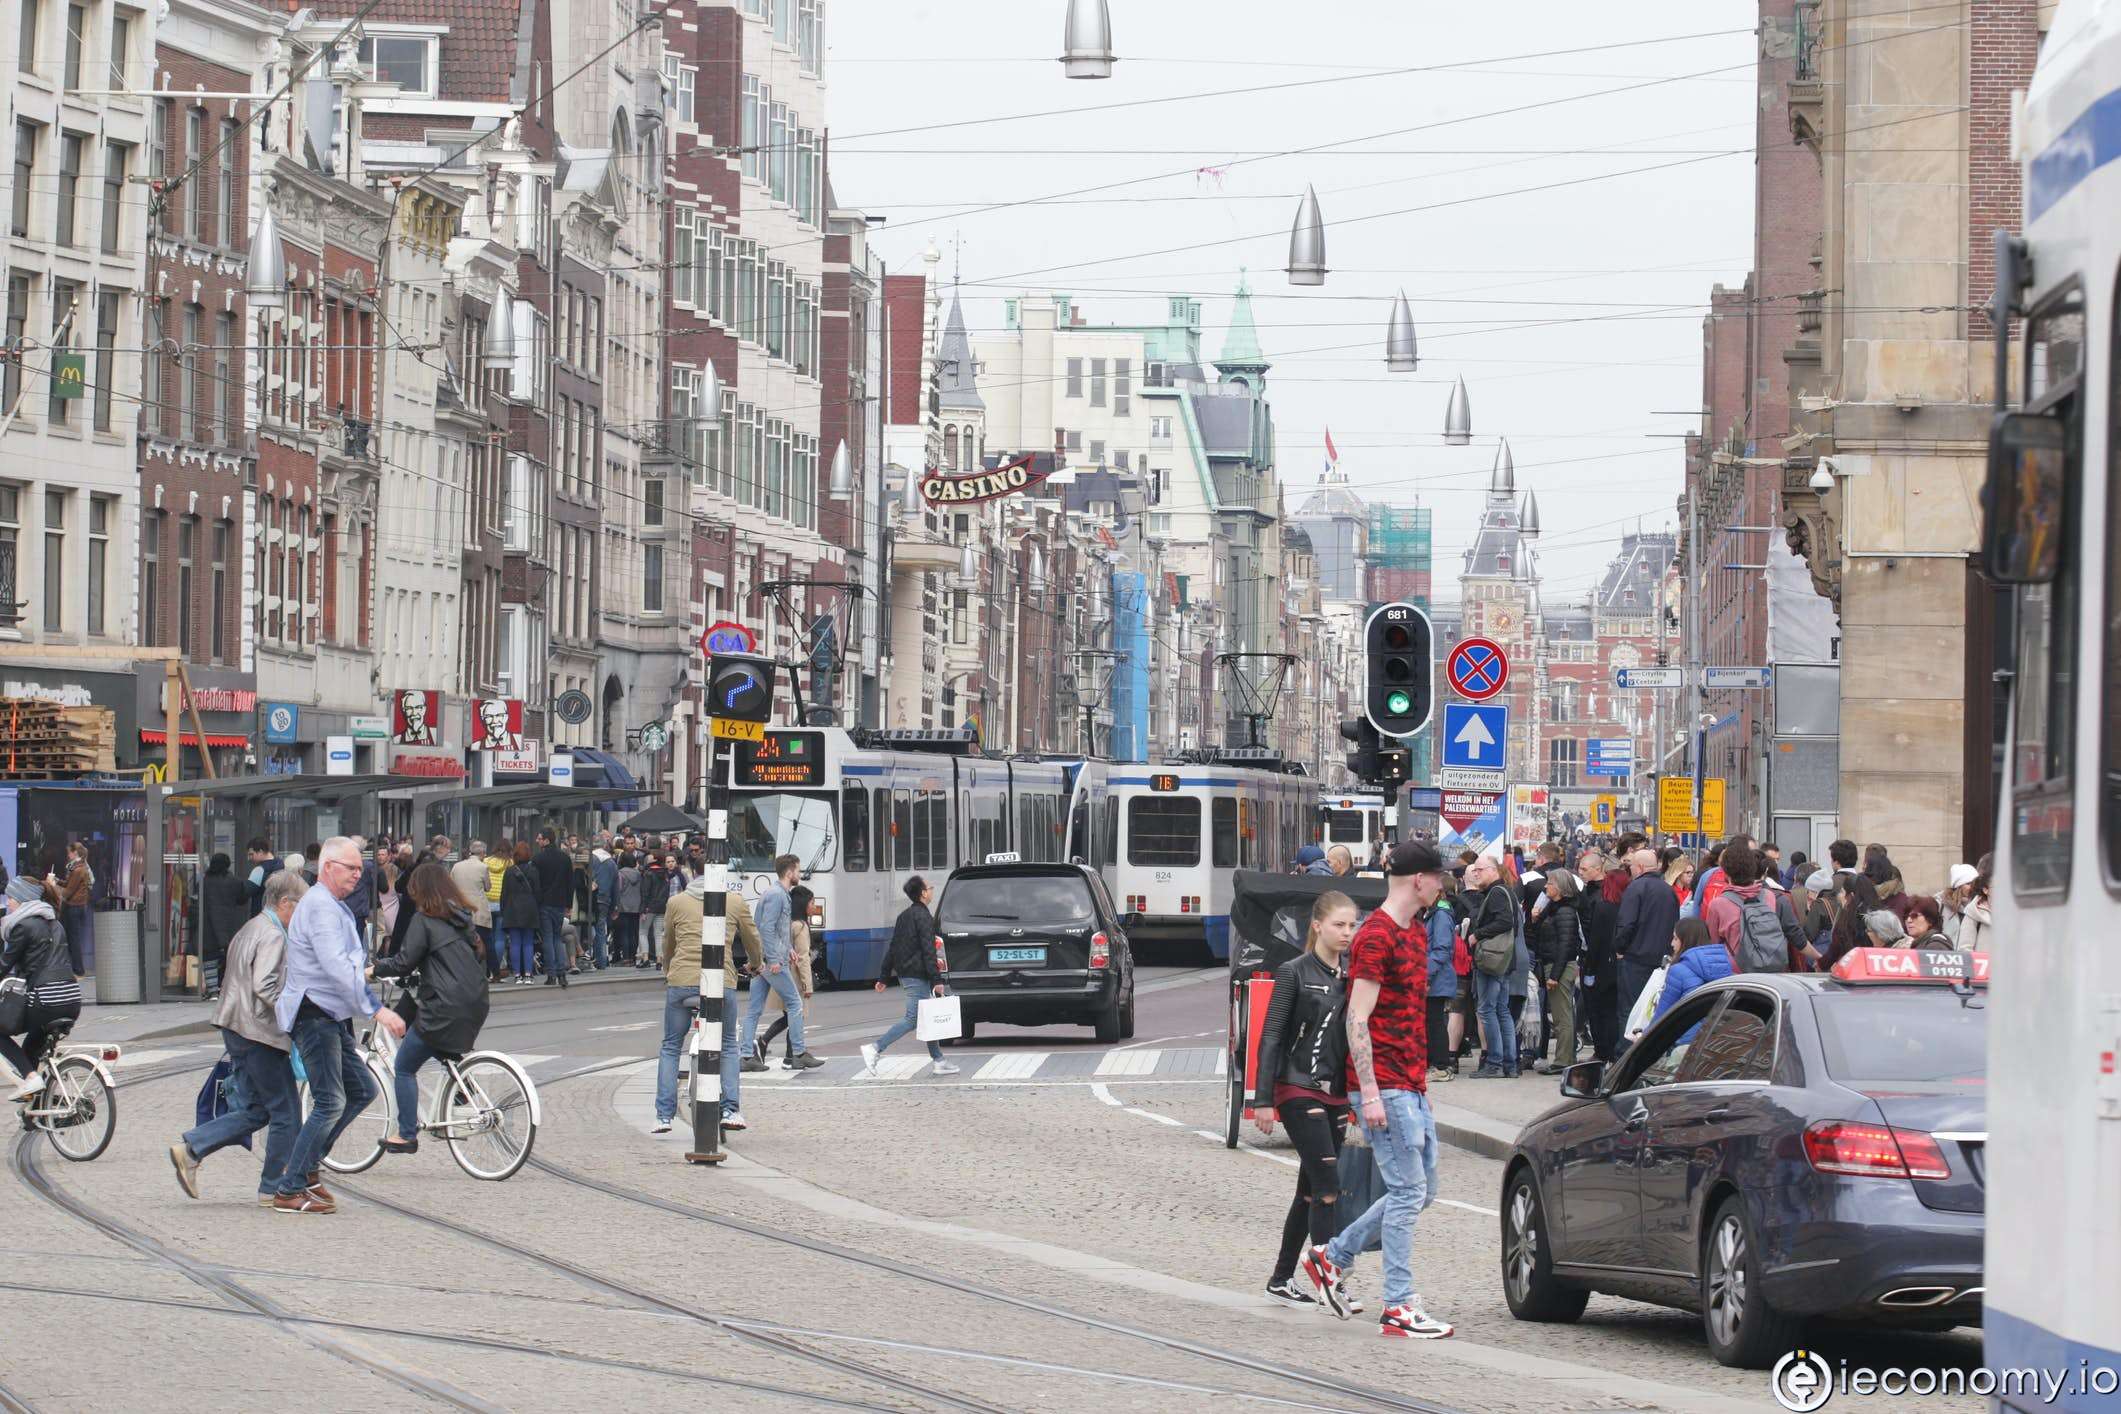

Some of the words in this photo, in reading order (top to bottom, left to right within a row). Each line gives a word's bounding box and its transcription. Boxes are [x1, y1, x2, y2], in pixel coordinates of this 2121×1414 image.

[924, 466, 1027, 500] CASINO
[1387, 609, 1407, 620] 681
[720, 720, 754, 737] 16-V
[501, 760, 534, 769] TICKETS
[1448, 772, 1499, 780] uitgezonderd
[1158, 776, 1173, 790] 16
[1444, 794, 1473, 804] WELKOM
[1473, 796, 1481, 804] IN
[1482, 796, 1495, 805] HET
[1444, 804, 1501, 814] PALEISKWARTIER!
[113, 809, 141, 821] HOTEL
[992, 853, 1015, 862] TAXI
[1155, 872, 1172, 880] 824
[727, 882, 743, 892] 29
[997, 949, 1039, 960] 52-SL-ST
[1868, 954, 1918, 974] TCA
[1926, 953, 1964, 966] TAXI
[1974, 959, 1988, 976] 7
[1932, 966, 1963, 977] 0192
